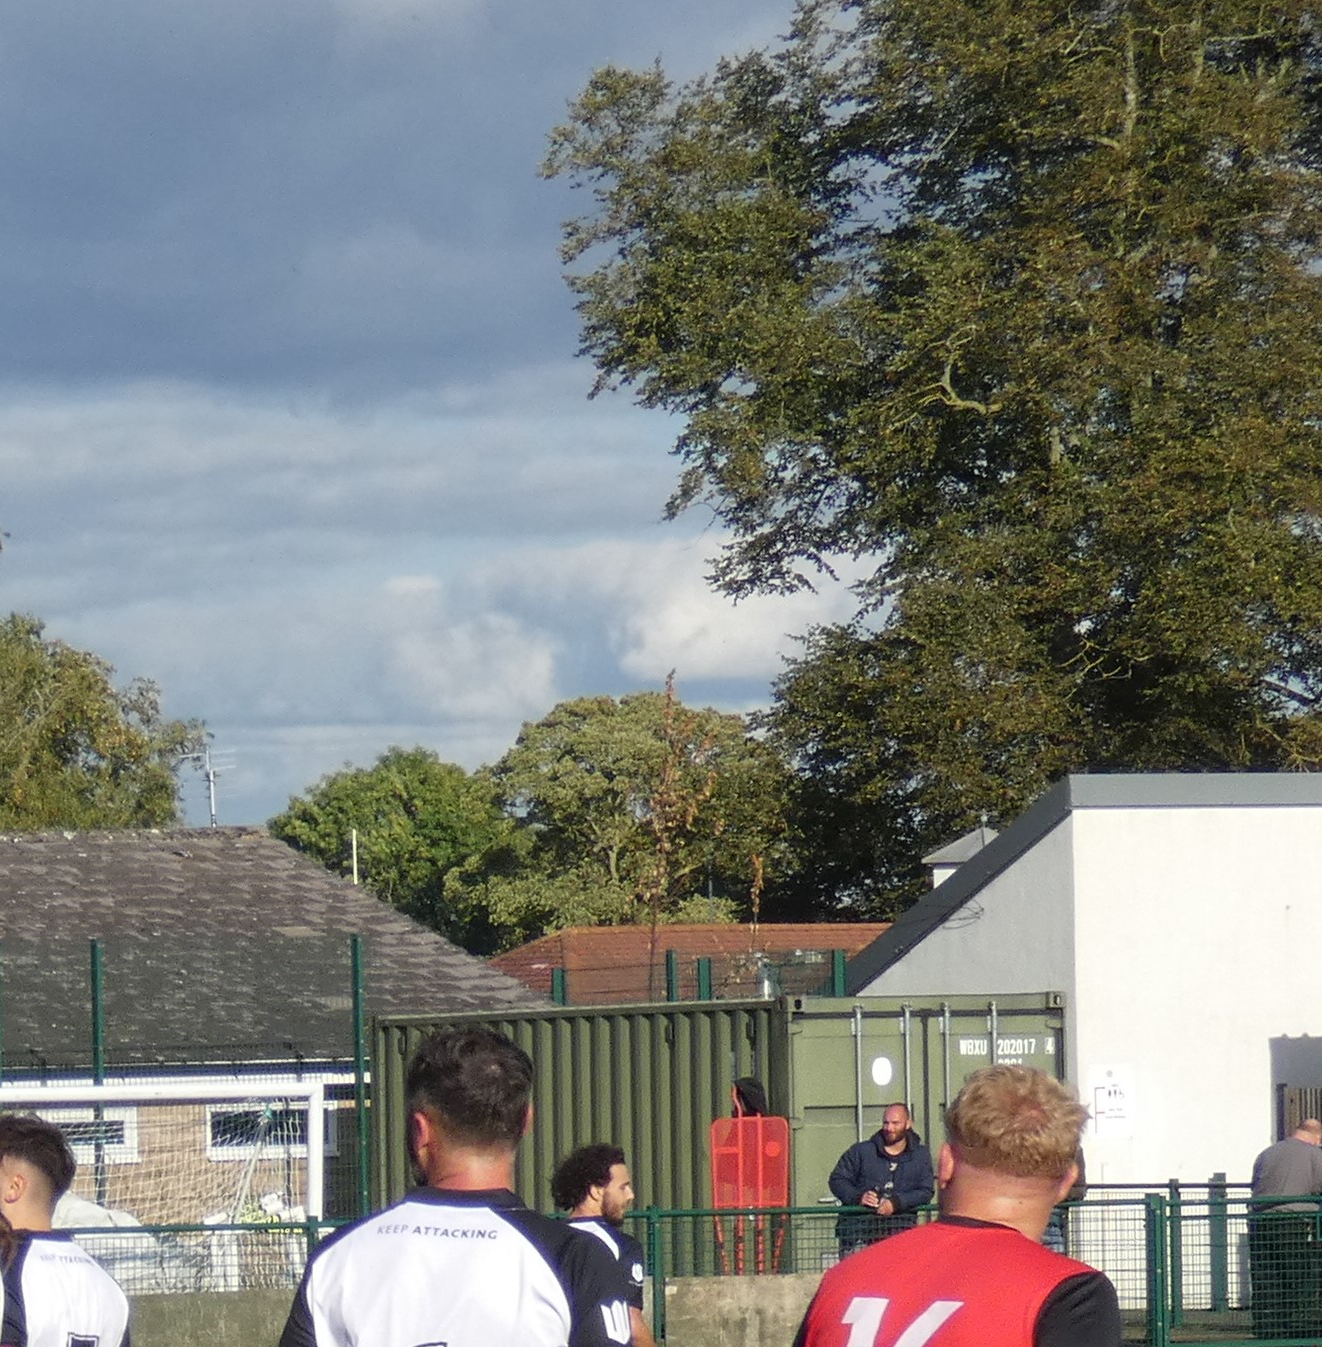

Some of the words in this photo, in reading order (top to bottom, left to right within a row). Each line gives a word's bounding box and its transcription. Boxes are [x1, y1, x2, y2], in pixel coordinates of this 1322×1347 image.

[959, 1038, 988, 1056] WBXU
[997, 1038, 1036, 1056] 202017
[376, 1223, 409, 1235] KEEP
[412, 1225, 498, 1240] ATTACKING
